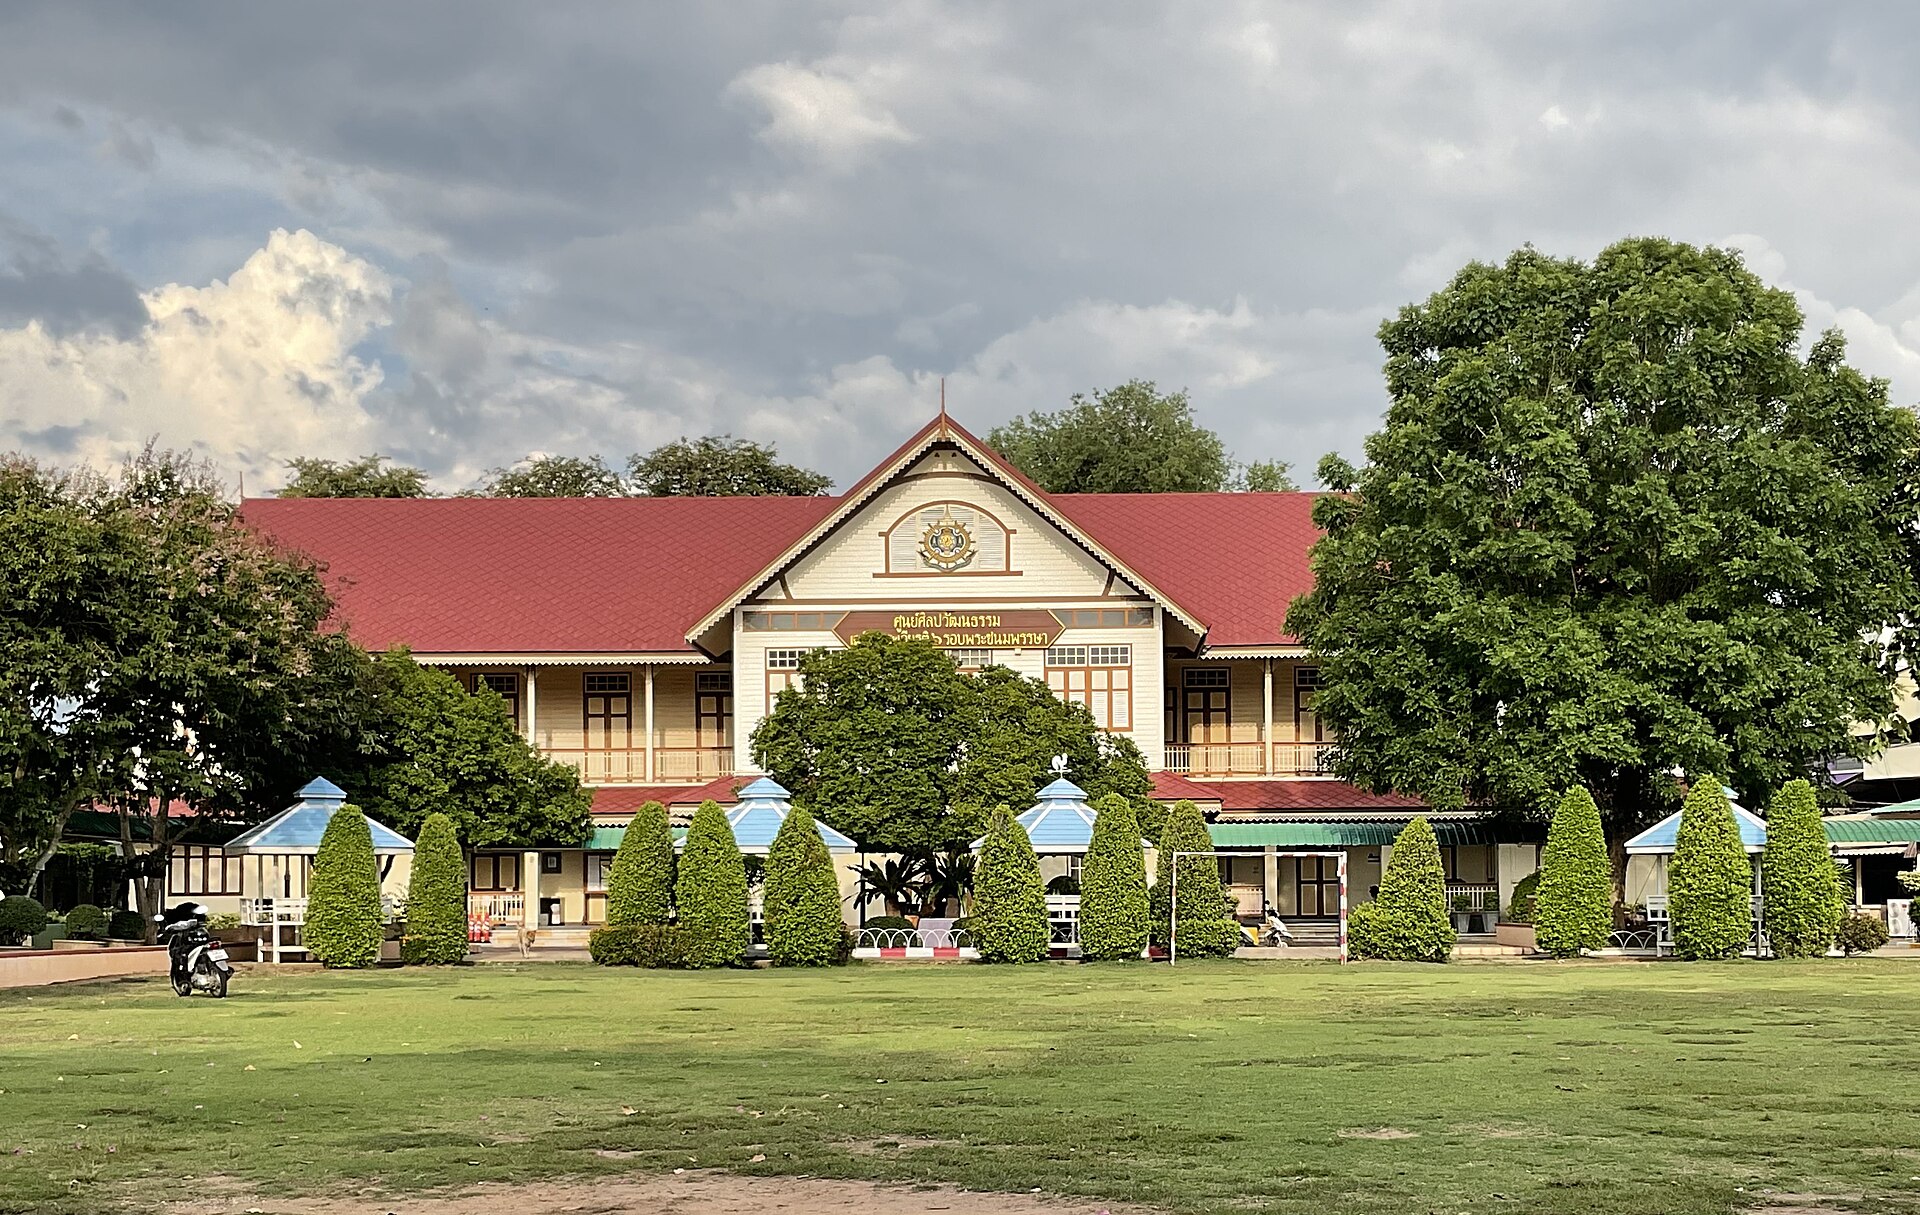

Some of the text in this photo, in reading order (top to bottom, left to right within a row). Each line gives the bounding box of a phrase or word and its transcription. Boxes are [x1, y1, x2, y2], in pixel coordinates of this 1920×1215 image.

[894, 612, 1001, 632] ศูนย์ศิลปวัฒนธรรม
